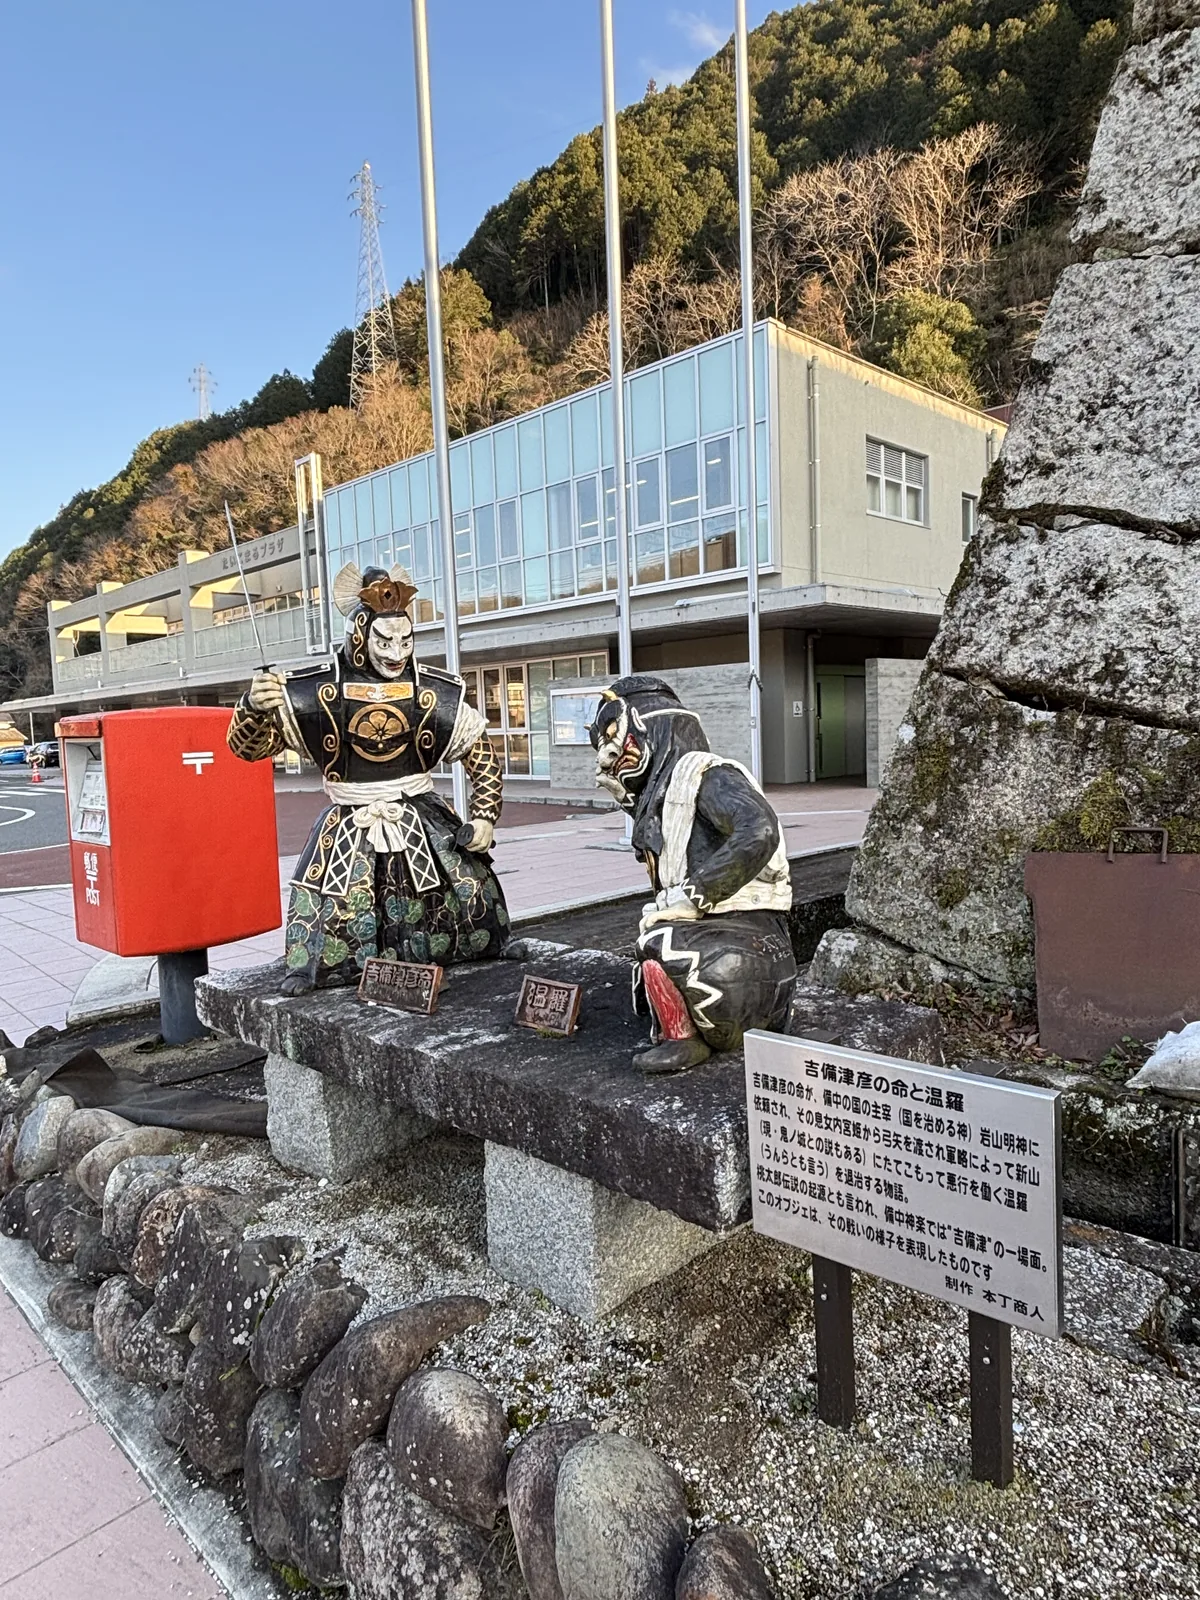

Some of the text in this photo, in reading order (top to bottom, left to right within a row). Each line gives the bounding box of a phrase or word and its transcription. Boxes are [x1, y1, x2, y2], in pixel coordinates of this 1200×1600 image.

[83, 851, 99, 873] 郵便
[85, 887, 100, 907] POST
[527, 982, 569, 1013] 温羅
[804, 1059, 965, 1113] 吉備津彦の命と温羅
[945, 1275, 1045, 1322] 制作 本丁商人
